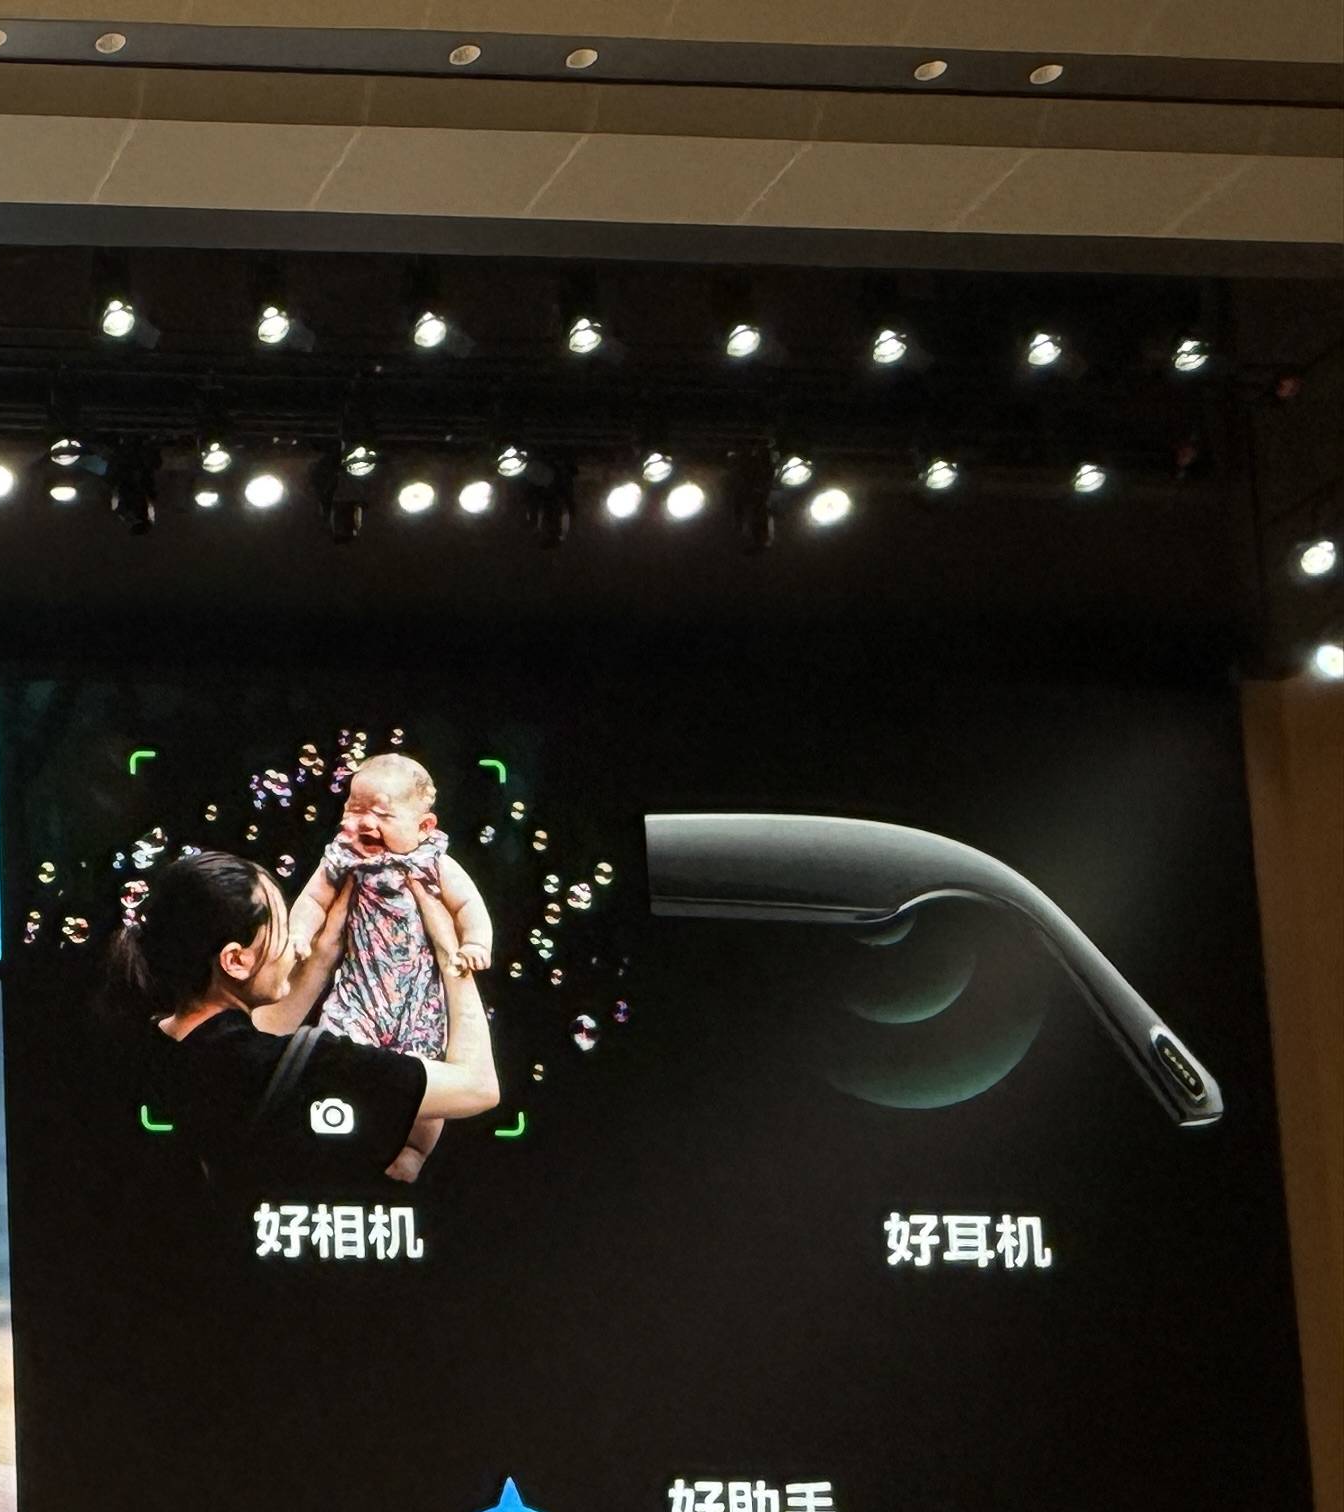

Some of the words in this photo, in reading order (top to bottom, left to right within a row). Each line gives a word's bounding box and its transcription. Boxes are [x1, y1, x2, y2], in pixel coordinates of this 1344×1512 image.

[254, 1203, 423, 1259] 好相机
[884, 1212, 1052, 1268] 好耳机
